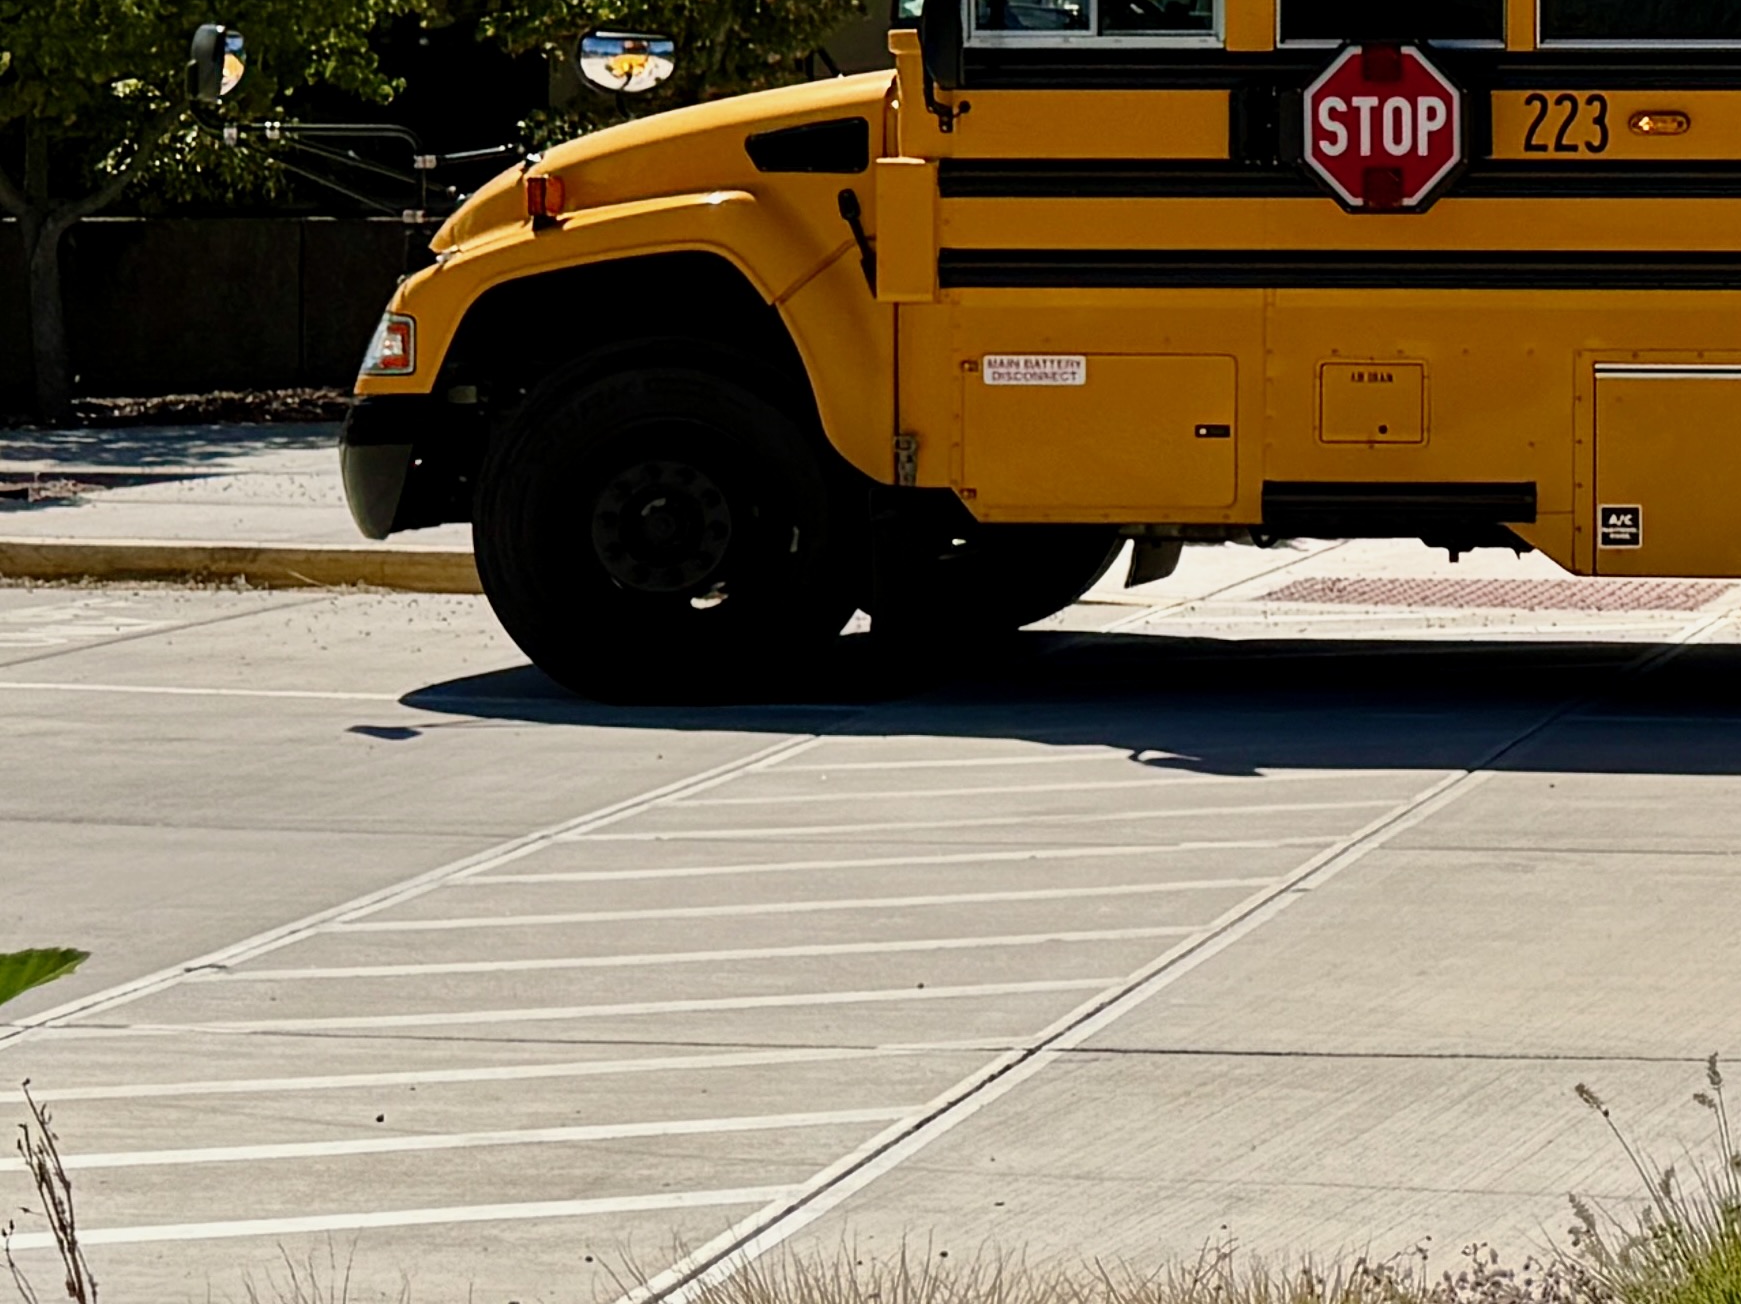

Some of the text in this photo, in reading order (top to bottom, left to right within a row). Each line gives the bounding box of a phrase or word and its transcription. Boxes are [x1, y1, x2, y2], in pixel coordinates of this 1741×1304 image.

[1318, 96, 1447, 157] STOP
[1523, 93, 1609, 154] 223
[1023, 358, 1081, 370] BATTERY
[991, 371, 1078, 382] DISCONNECT
[1608, 513, 1633, 527] A/C
